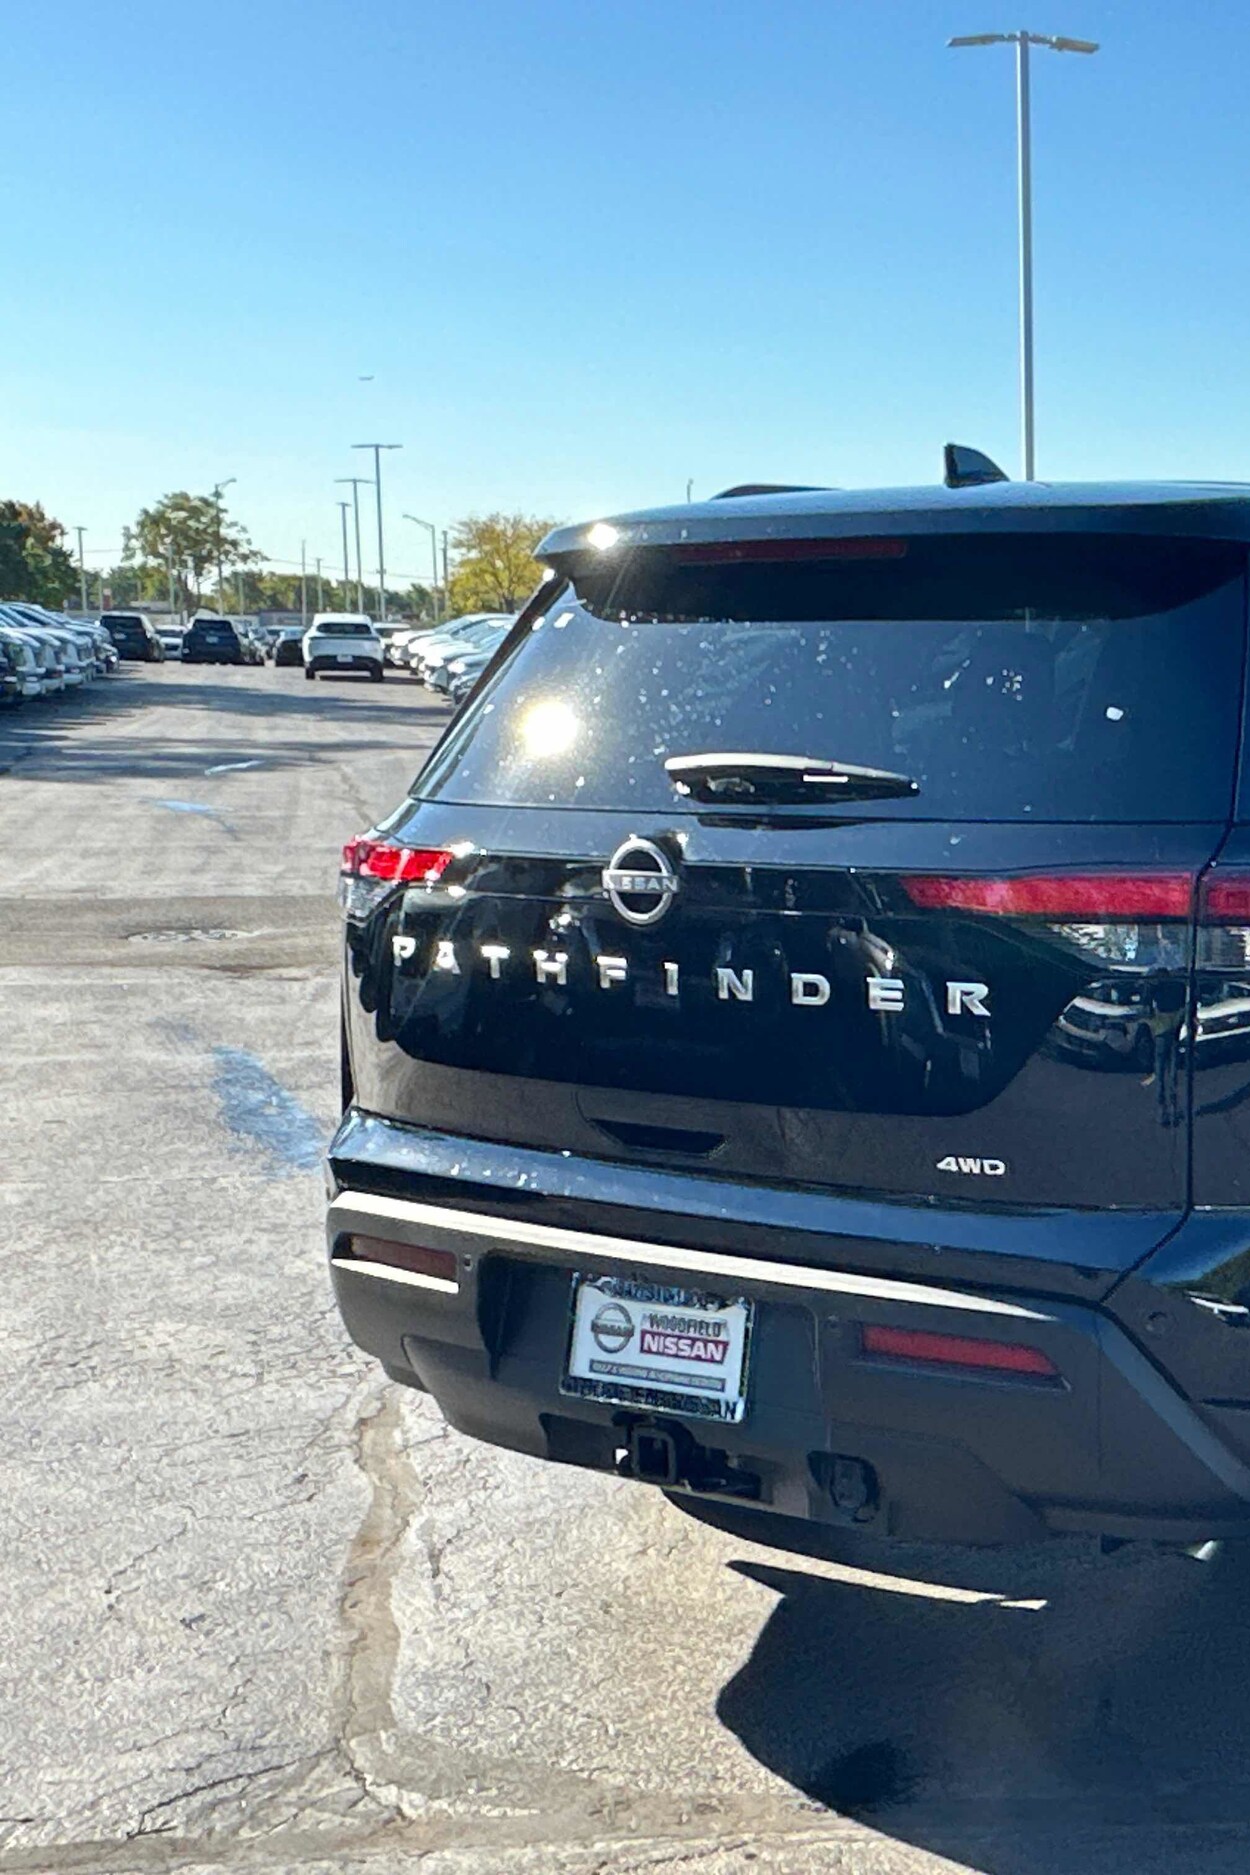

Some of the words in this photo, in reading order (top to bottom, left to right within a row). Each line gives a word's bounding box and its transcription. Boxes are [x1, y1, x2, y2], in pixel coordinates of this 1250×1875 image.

[391, 935, 992, 1018] PATHFINDER
[935, 1156, 1006, 1176] 4WD
[642, 1333, 724, 1361] NISSAN
